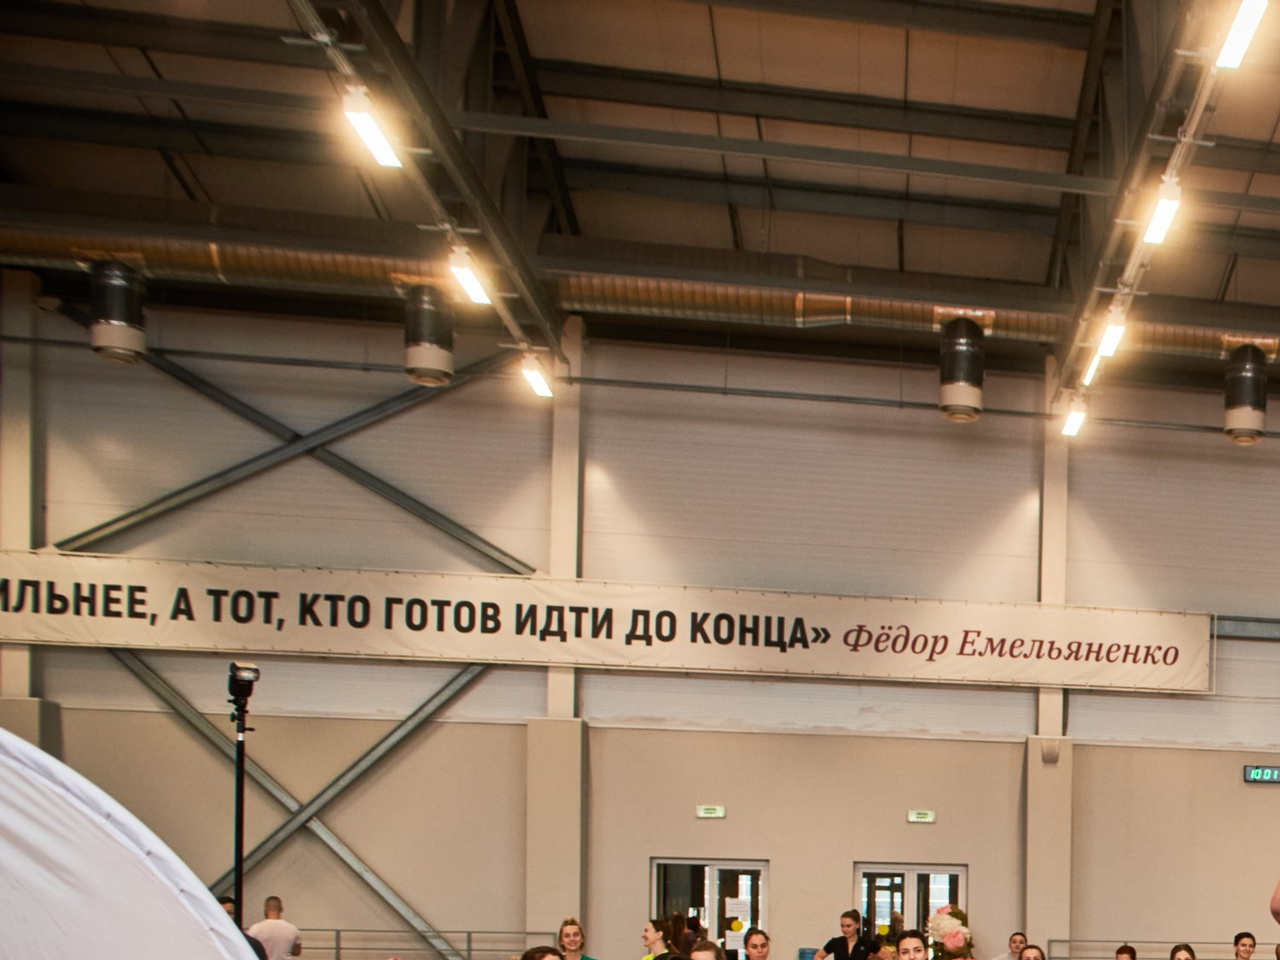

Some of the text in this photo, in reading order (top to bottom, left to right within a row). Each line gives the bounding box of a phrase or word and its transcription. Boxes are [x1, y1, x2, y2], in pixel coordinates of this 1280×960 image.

[170, 588, 195, 621] А
[206, 588, 285, 631] ТОТ,
[299, 593, 370, 629] КТО
[385, 596, 501, 634] ГОТОВ
[515, 602, 614, 642] ИДТИ
[625, 608, 677, 646] ДО
[690, 611, 831, 653] КОНЦА»
[842, 622, 949, 661] Фёдор
[956, 629, 1181, 667] Емельяненко
